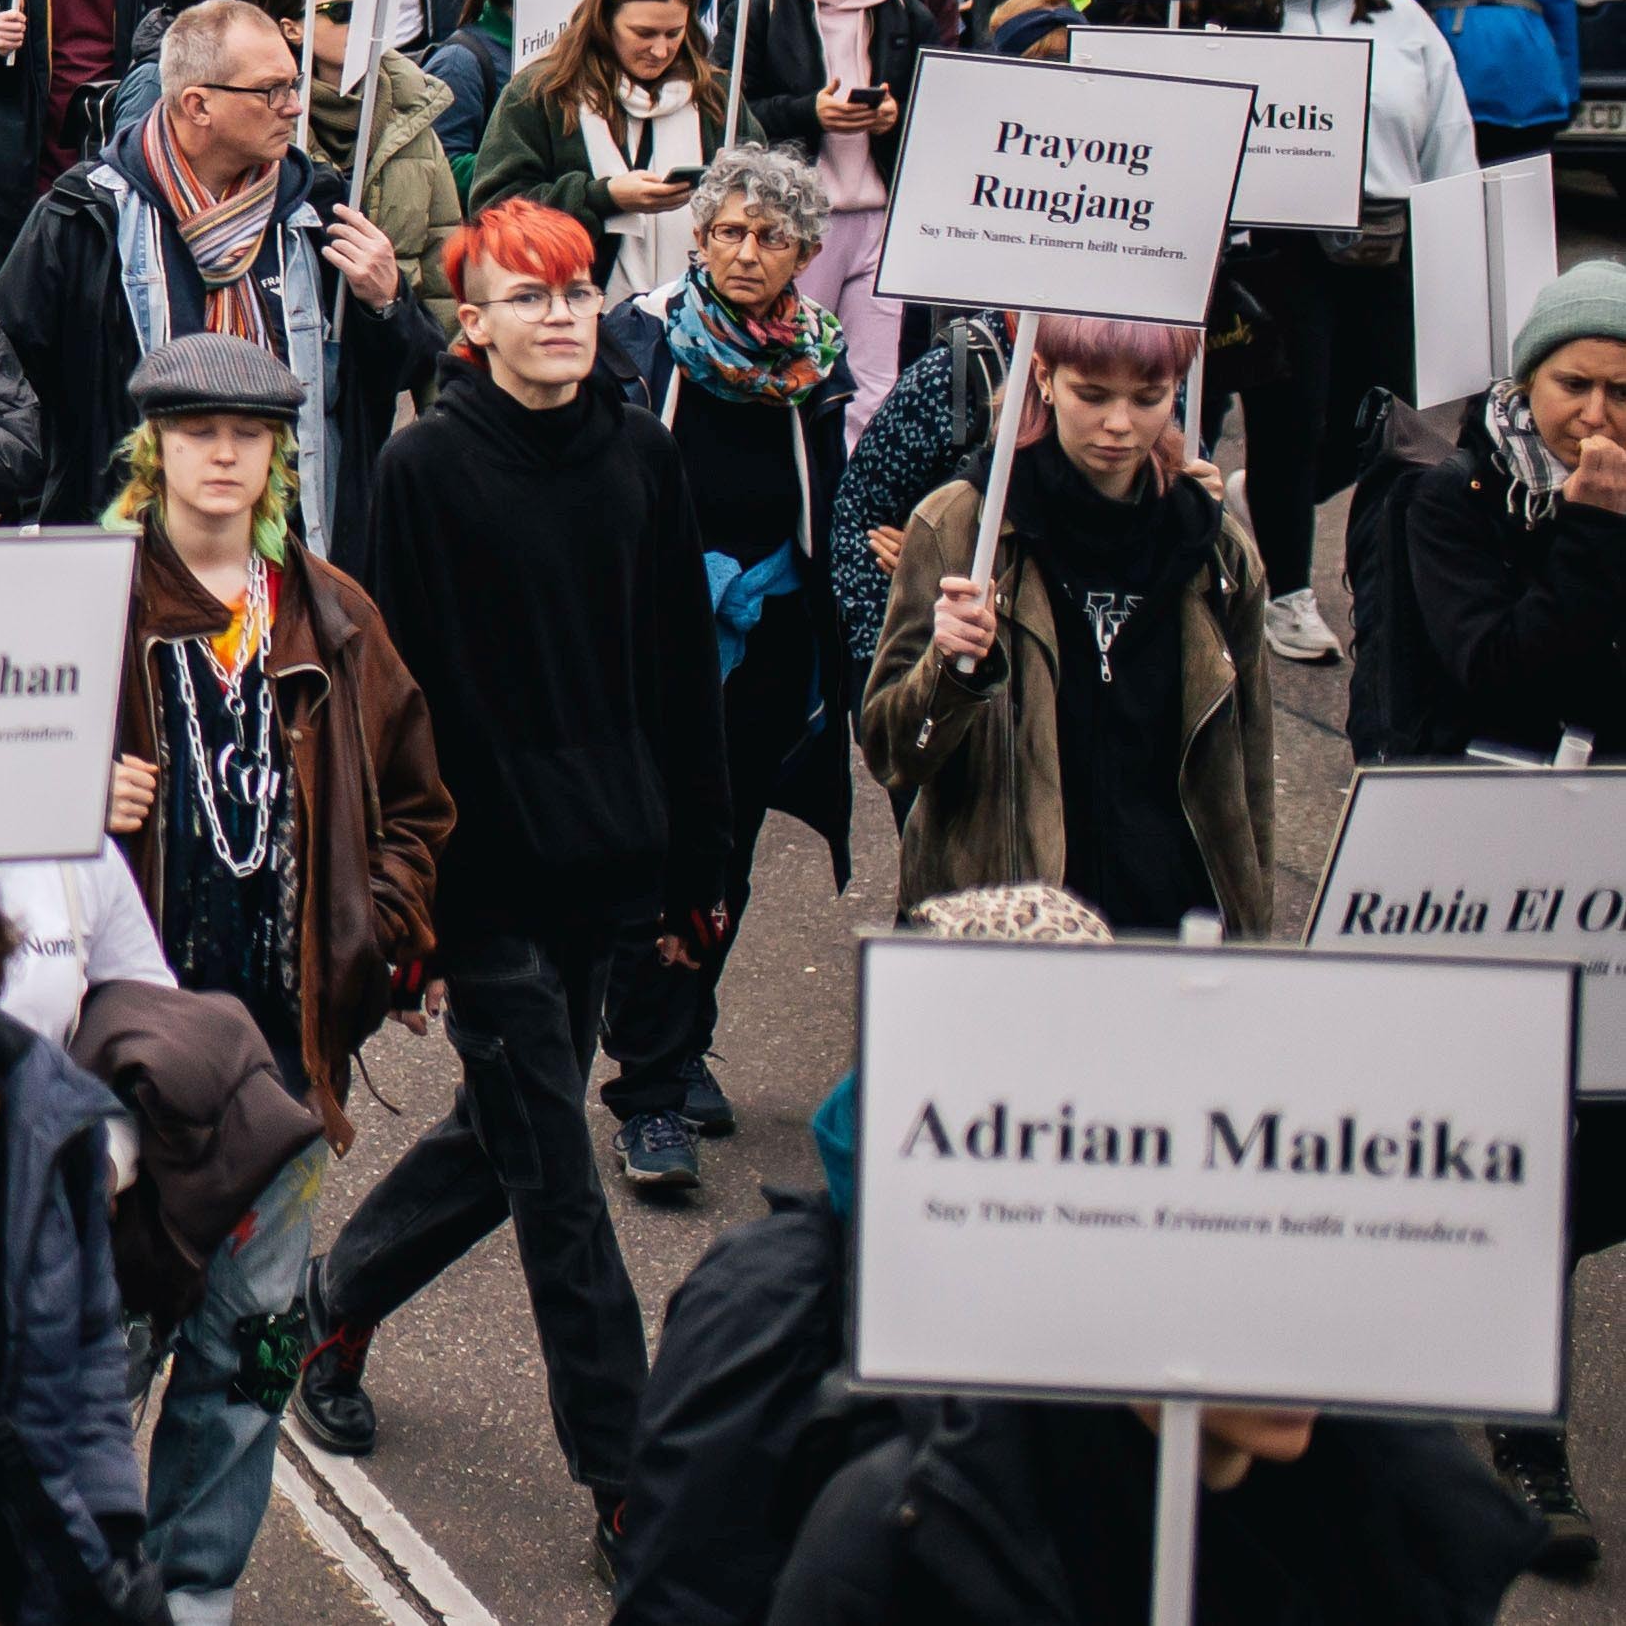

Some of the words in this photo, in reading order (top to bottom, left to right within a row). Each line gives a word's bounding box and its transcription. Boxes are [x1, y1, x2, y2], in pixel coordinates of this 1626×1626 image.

[1249, 103, 1335, 132] Melis
[994, 120, 1153, 176] Prayong
[1275, 146, 1336, 159] verändern.
[970, 174, 1155, 232] Rungjang
[919, 224, 941, 238] Say
[946, 225, 980, 240] Their
[981, 230, 1026, 244] Names.
[1029, 234, 1084, 250] Erinnern
[1087, 239, 1118, 254] heißt
[1121, 244, 1188, 261] verändern.
[1339, 887, 1490, 936] Rabia
[1505, 888, 1565, 934] El
[1577, 888, 1626, 934] O
[899, 1096, 1174, 1169] Adrian
[1201, 1107, 1526, 1186] Maleika
[923, 1199, 968, 1224] Say
[981, 1202, 1045, 1226] Their
[1056, 1204, 1142, 1231] Names.
[1154, 1210, 1273, 1236] Erinnern
[1354, 1218, 1498, 1246] verändern.
